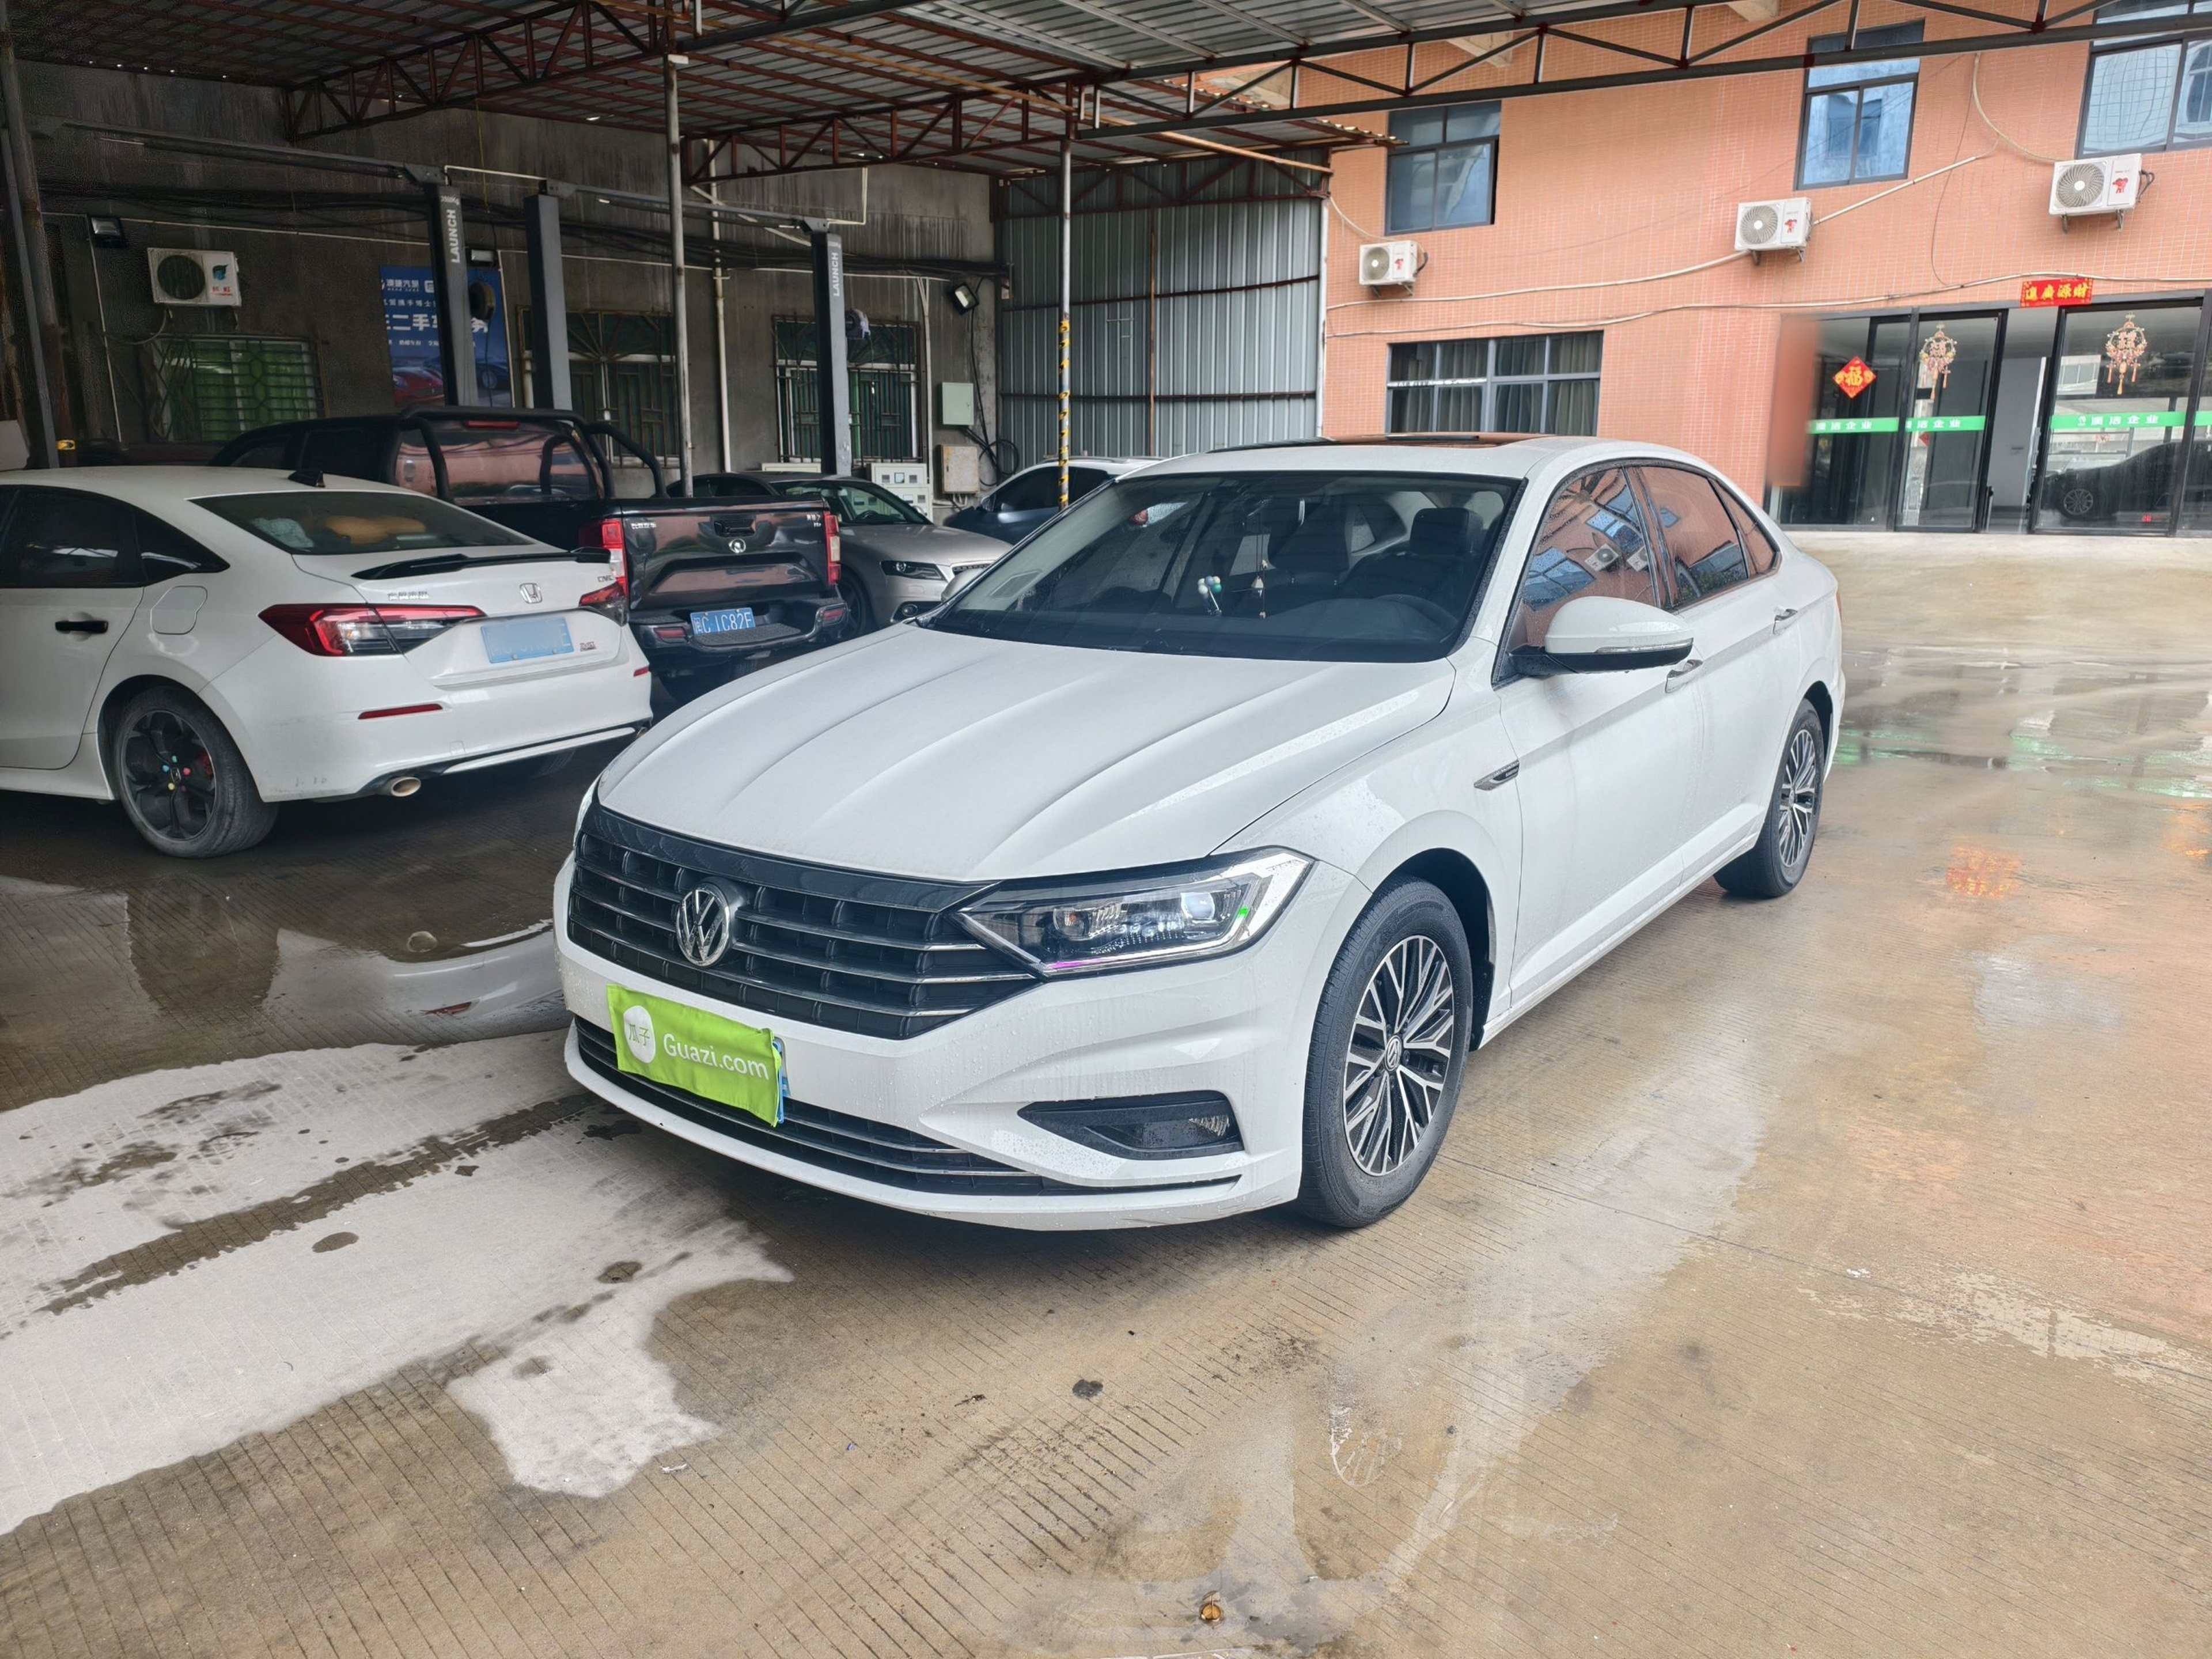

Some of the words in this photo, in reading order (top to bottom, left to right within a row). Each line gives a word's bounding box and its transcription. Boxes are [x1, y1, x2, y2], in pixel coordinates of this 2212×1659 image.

[446, 209, 460, 263] LAUNCH
[831, 252, 840, 297] LAUNCH
[628, 1023, 650, 1047] 瓜子
[663, 1033, 770, 1080] Guazi.com
